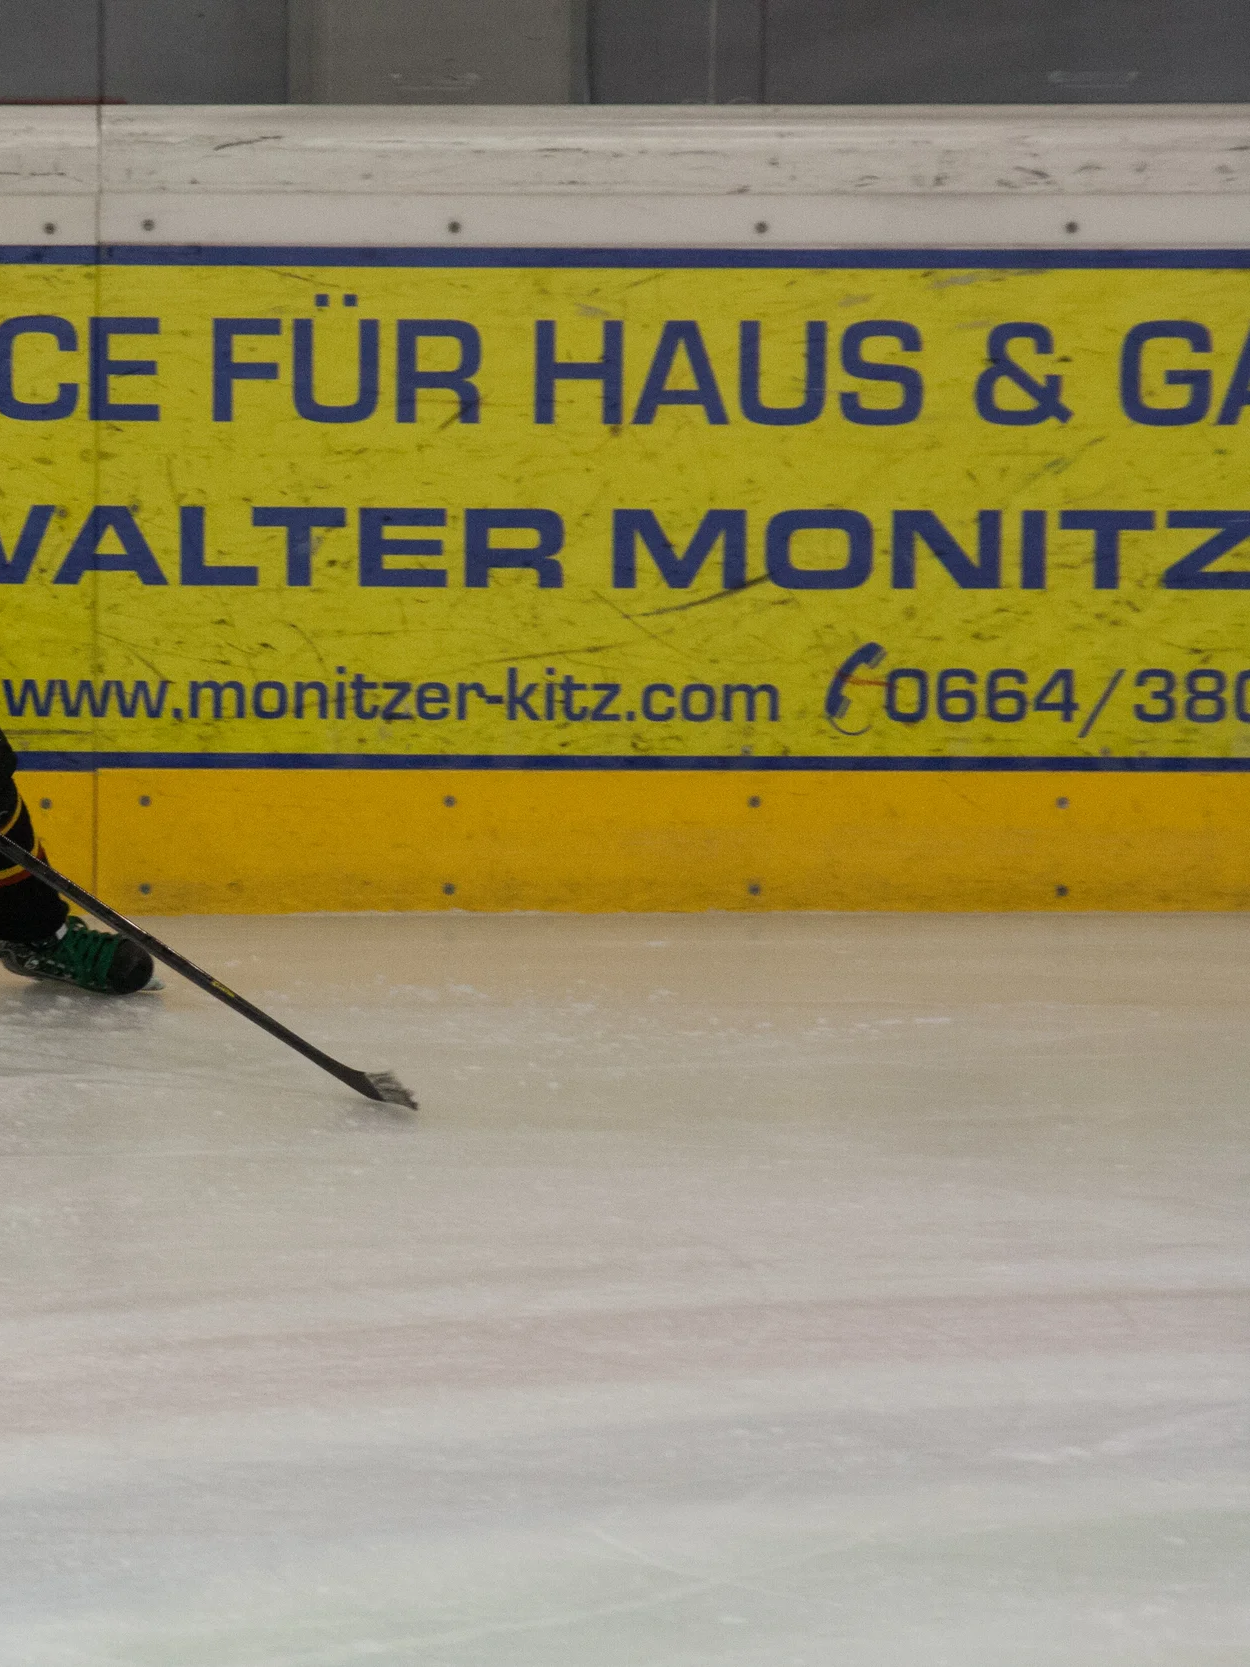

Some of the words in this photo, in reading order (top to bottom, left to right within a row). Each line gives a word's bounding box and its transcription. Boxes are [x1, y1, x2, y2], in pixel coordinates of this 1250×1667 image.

[212, 294, 482, 424] FÜR
[534, 320, 924, 426] HAUS
[974, 322, 1074, 426] &
[612, 508, 1250, 590] MONITZ
[2, 665, 780, 722] www.monitzer-kitz.com
